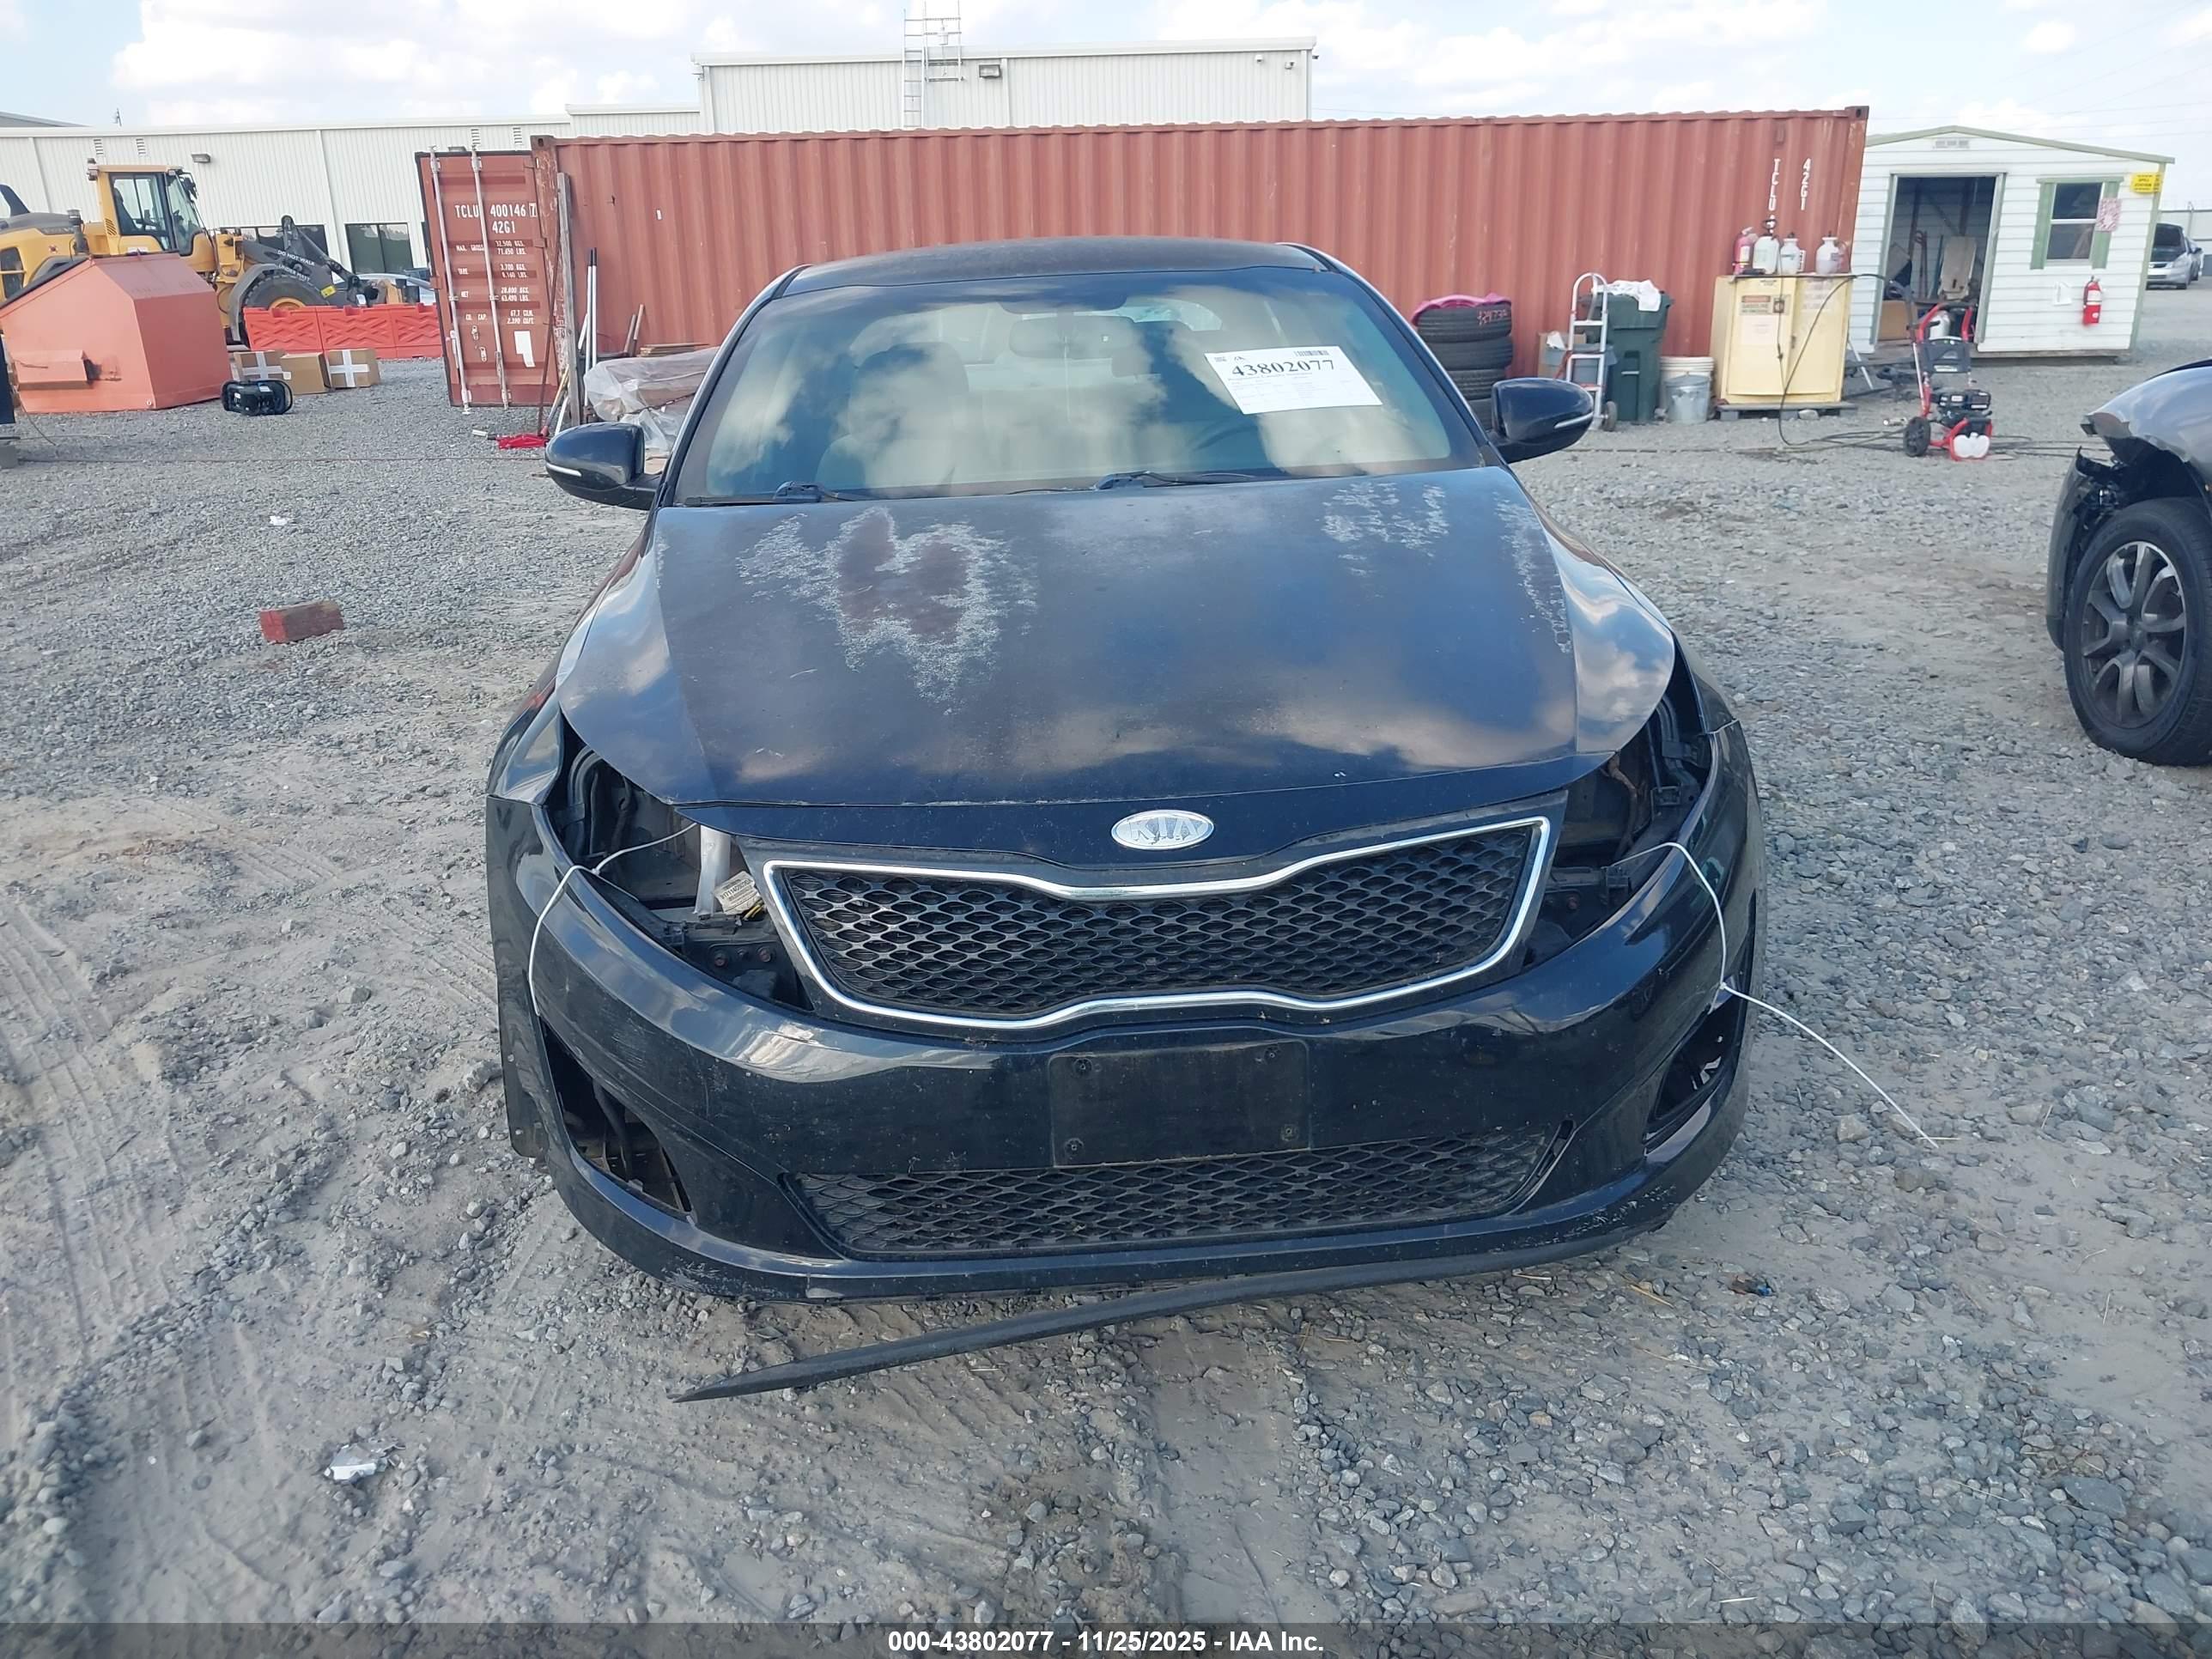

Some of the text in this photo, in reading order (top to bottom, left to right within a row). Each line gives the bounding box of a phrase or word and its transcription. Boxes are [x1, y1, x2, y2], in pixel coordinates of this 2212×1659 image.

[1767, 157, 1782, 211] TCLU
[1800, 157, 1812, 211] 42G1
[455, 203, 538, 218] TCLU 400146 7
[492, 220, 516, 234] 42G1
[299, 258, 315, 266] WALK
[1231, 358, 1335, 377] 43802077
[1126, 815, 1207, 843] KIA
